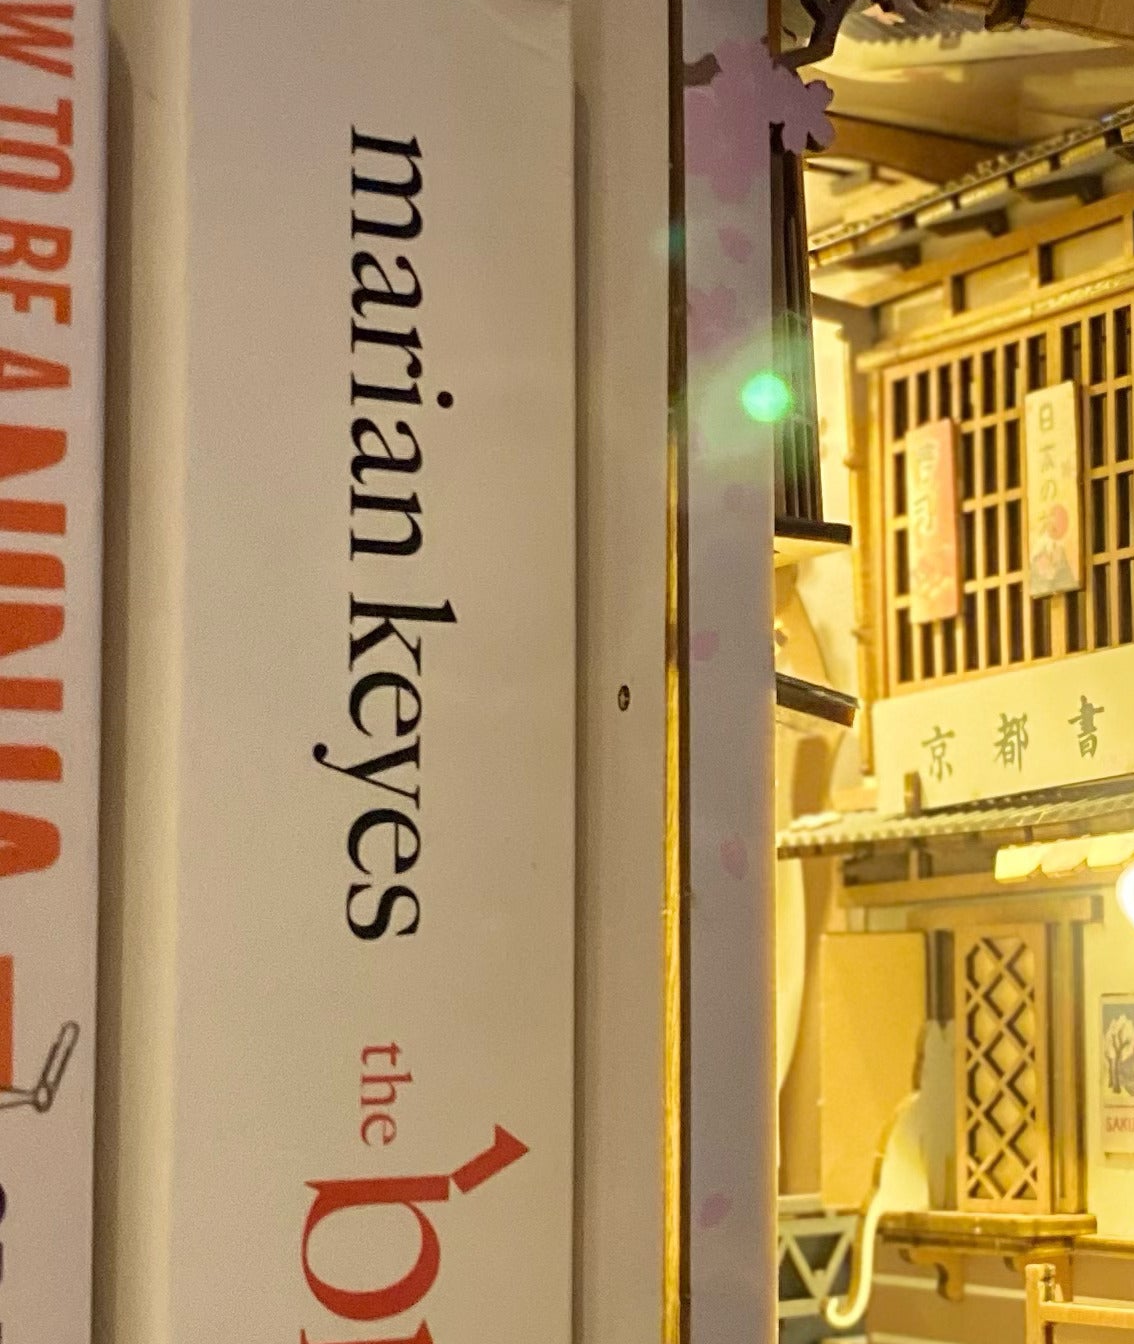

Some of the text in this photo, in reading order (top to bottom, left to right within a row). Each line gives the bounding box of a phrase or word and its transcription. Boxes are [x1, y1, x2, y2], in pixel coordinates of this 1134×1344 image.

[0, 98, 74, 194] TO
[0, 218, 72, 326] BE
[312, 124, 458, 942] marian keyes
[360, 1040, 414, 1146] the
